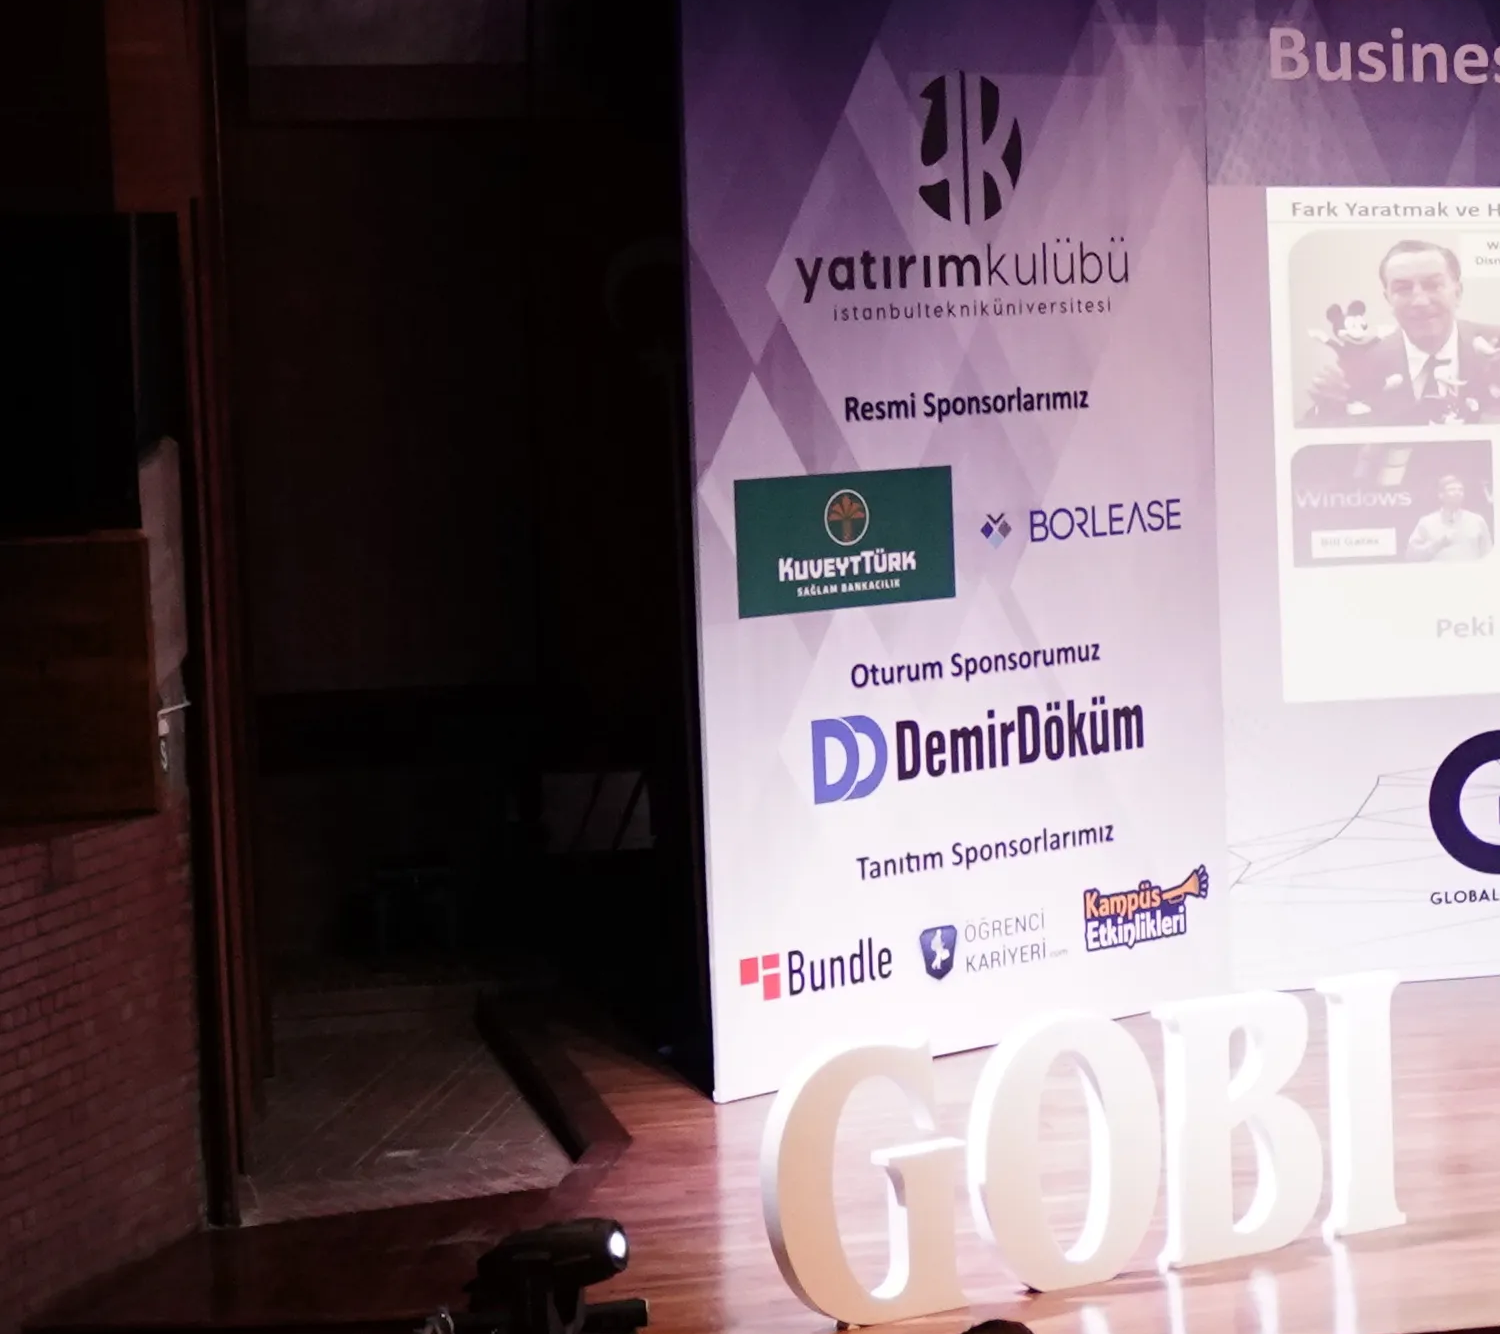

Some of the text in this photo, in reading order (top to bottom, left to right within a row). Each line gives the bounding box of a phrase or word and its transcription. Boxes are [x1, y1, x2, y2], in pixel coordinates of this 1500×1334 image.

[1290, 201, 1339, 218] Fark
[1345, 201, 1449, 218] Yaratmak
[1455, 204, 1480, 218] ve
[795, 236, 1130, 304] yatırımkulübü
[833, 296, 1112, 322] istanbultekniküniversitesi
[844, 387, 1090, 422] Resmi Sponsorlarımız
[1029, 499, 1182, 542] BORLEASE
[797, 579, 901, 597] SAĞLAM BANKACILIK
[1436, 616, 1494, 638] Peki
[851, 642, 1102, 688] Oturum Sponsorumuz
[896, 696, 1145, 781] DemirDöküm
[857, 824, 1115, 881] Tanıtım Sponsorlarımız
[1084, 881, 1161, 919] Kampüs
[1430, 888, 1500, 905] GLOBAL
[964, 909, 1045, 943] ÖĞRENCİ
[1085, 906, 1186, 951] Etkinlikleri
[788, 939, 893, 995] Bundle
[965, 937, 1046, 973] KARİYERİ
[760, 970, 1407, 1329] GOBI
